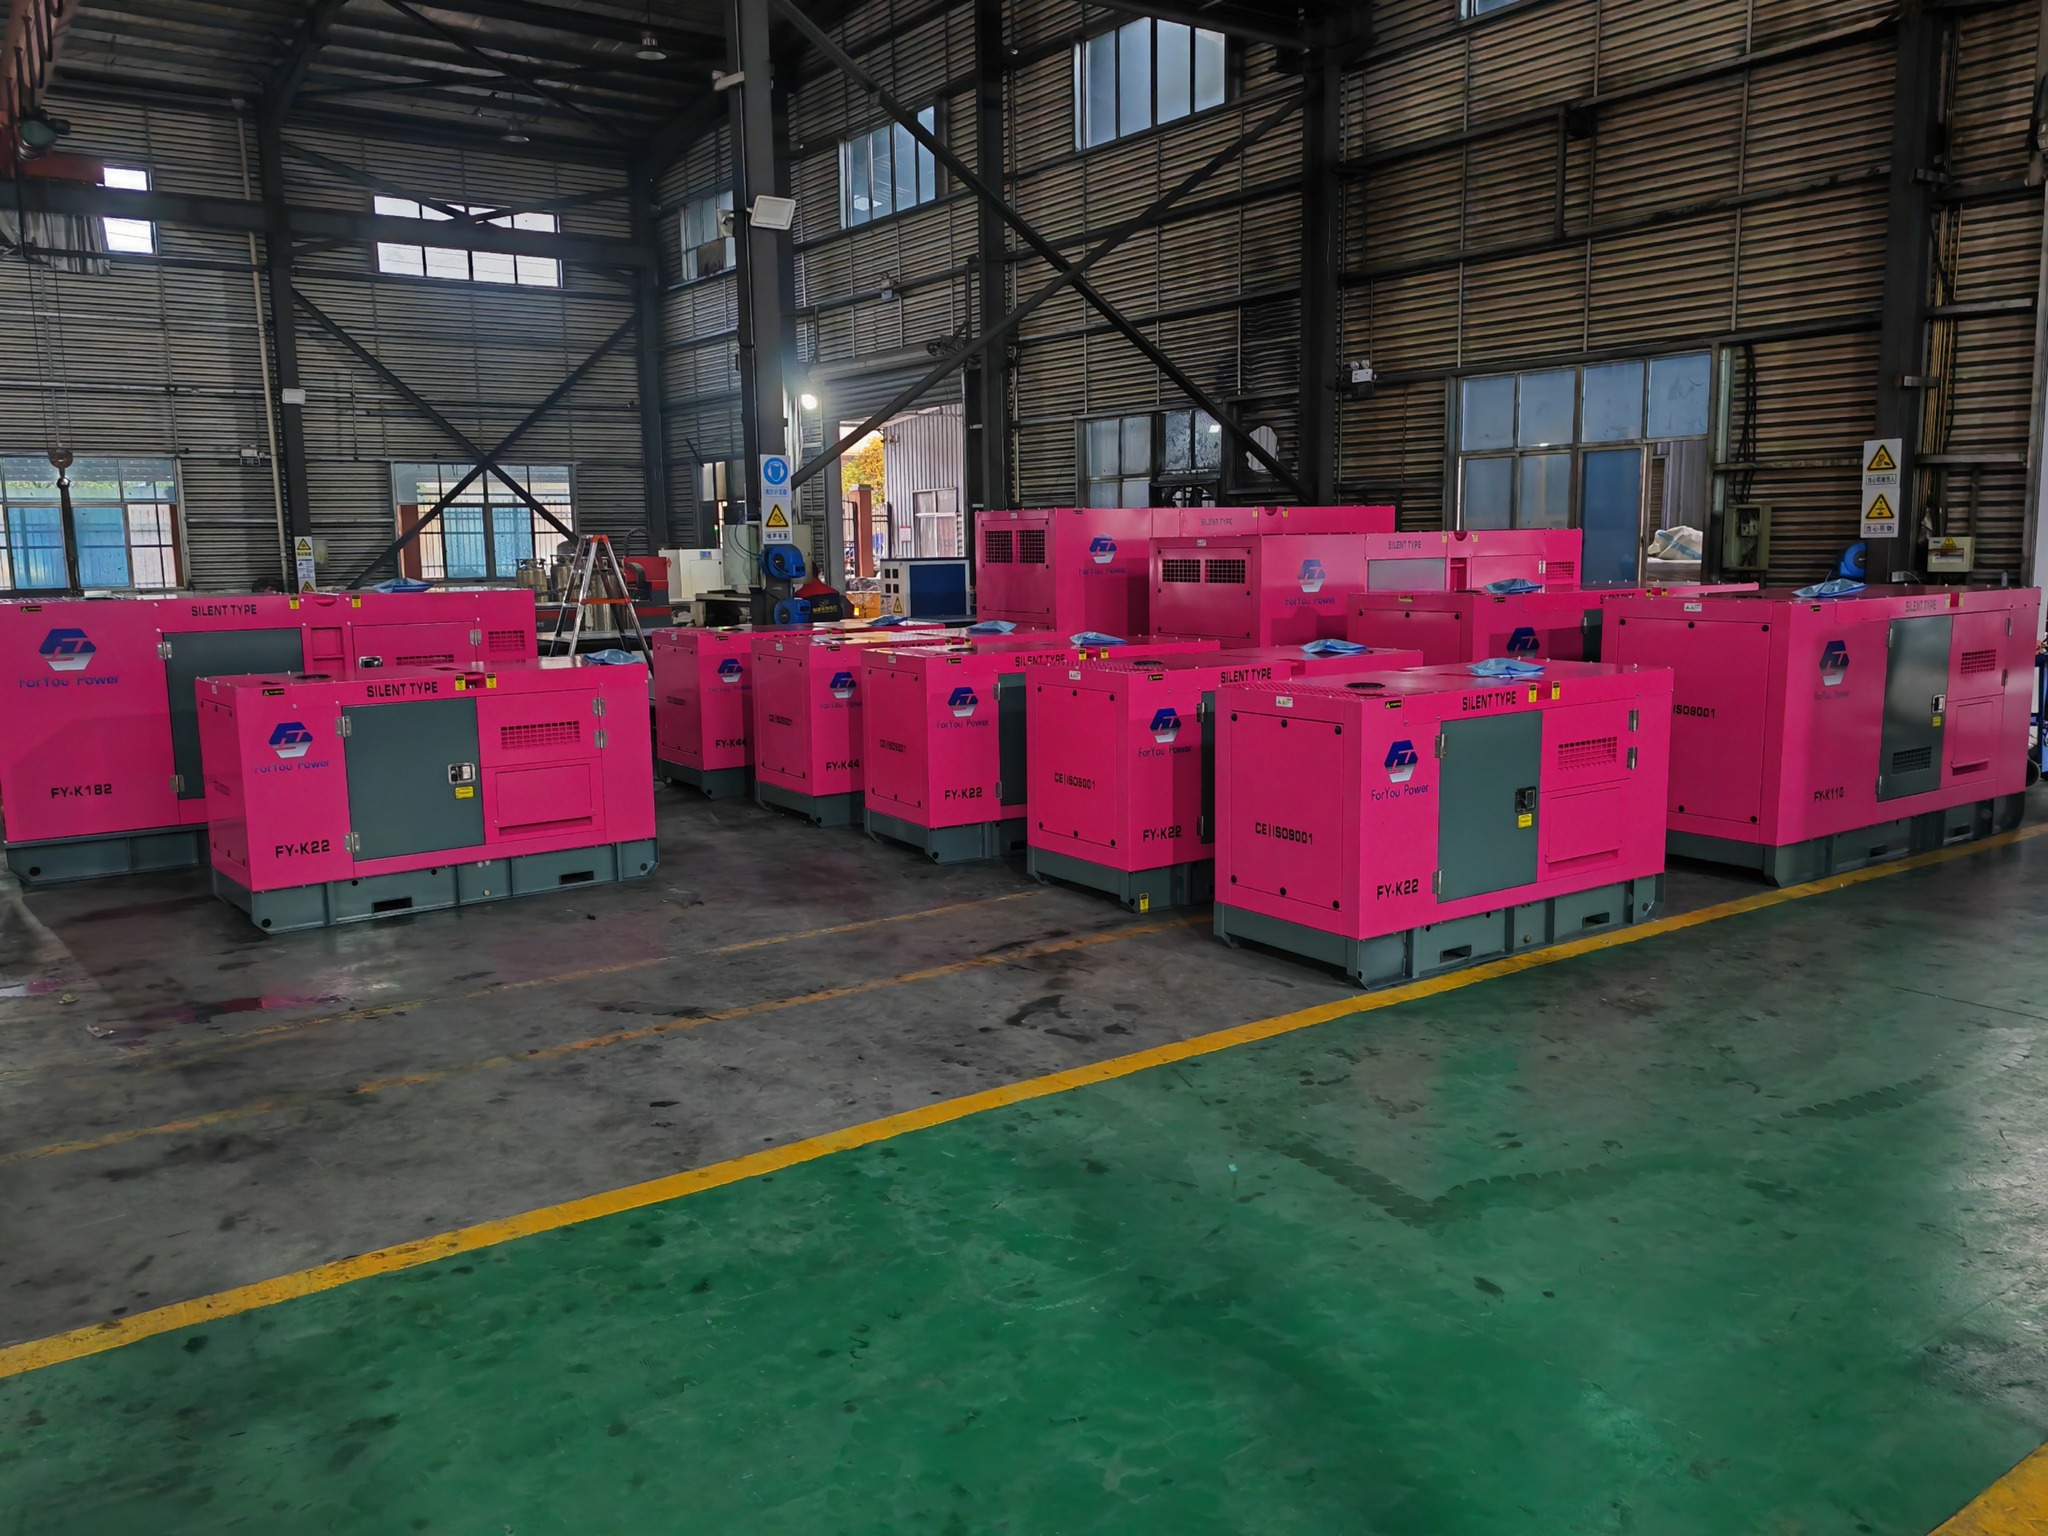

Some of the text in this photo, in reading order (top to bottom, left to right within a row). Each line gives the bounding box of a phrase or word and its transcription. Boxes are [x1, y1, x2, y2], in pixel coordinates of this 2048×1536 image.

[1388, 540, 1421, 549] SILENT TYPE
[192, 604, 257, 616] SILENT TYPE
[1015, 655, 1043, 666] SILENT
[19, 675, 119, 688] ForYou Power
[1221, 668, 1272, 683] SILENT TYPE
[367, 682, 438, 697] SILENT TYPE
[1462, 691, 1516, 711] SILENT TYPE
[937, 719, 989, 729] ForYou Power
[716, 738, 747, 748] FY-K44
[1138, 745, 1192, 757] ForYou Power
[298, 760, 329, 770] Power
[826, 759, 860, 771] FY-K44
[51, 784, 112, 798] FY-K182
[945, 787, 982, 800] FY-K22
[1372, 784, 1429, 800] ForYou Power
[1814, 787, 1844, 803] FY-K110
[1143, 825, 1182, 842] FY-K22
[275, 840, 330, 858] FY-K22
[1377, 879, 1419, 900] FY-K22
